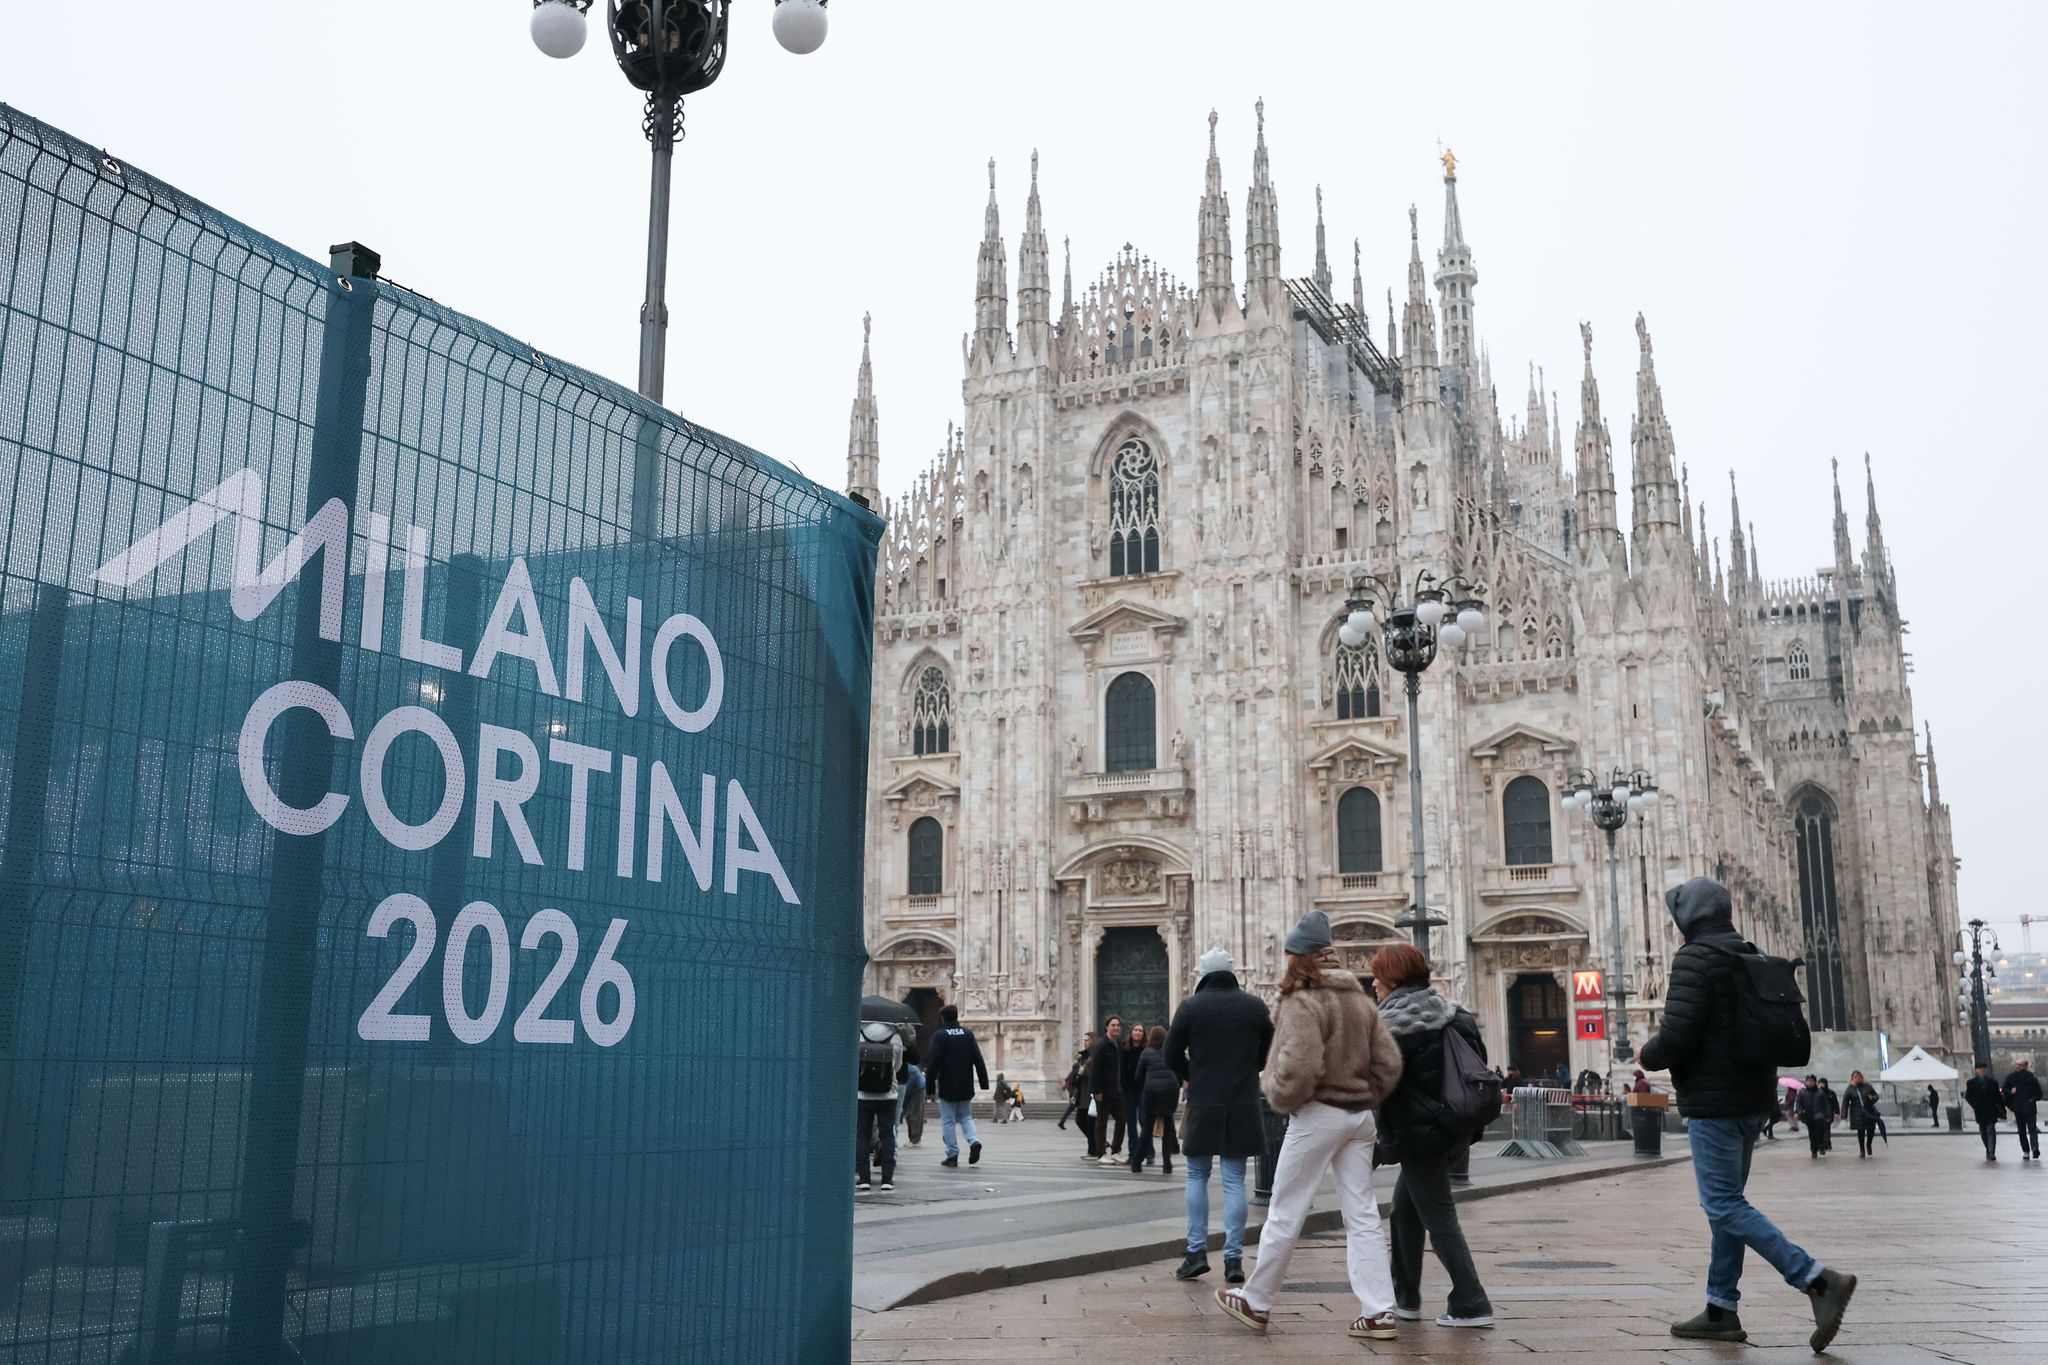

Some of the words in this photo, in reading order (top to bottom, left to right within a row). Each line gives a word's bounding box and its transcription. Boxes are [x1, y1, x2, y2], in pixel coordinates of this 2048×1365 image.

[90, 467, 724, 732] MILANO
[239, 681, 800, 904] CORTINA
[358, 893, 635, 1045] 2026
[946, 1028, 965, 1036] VISA
[1576, 975, 1600, 995] M
